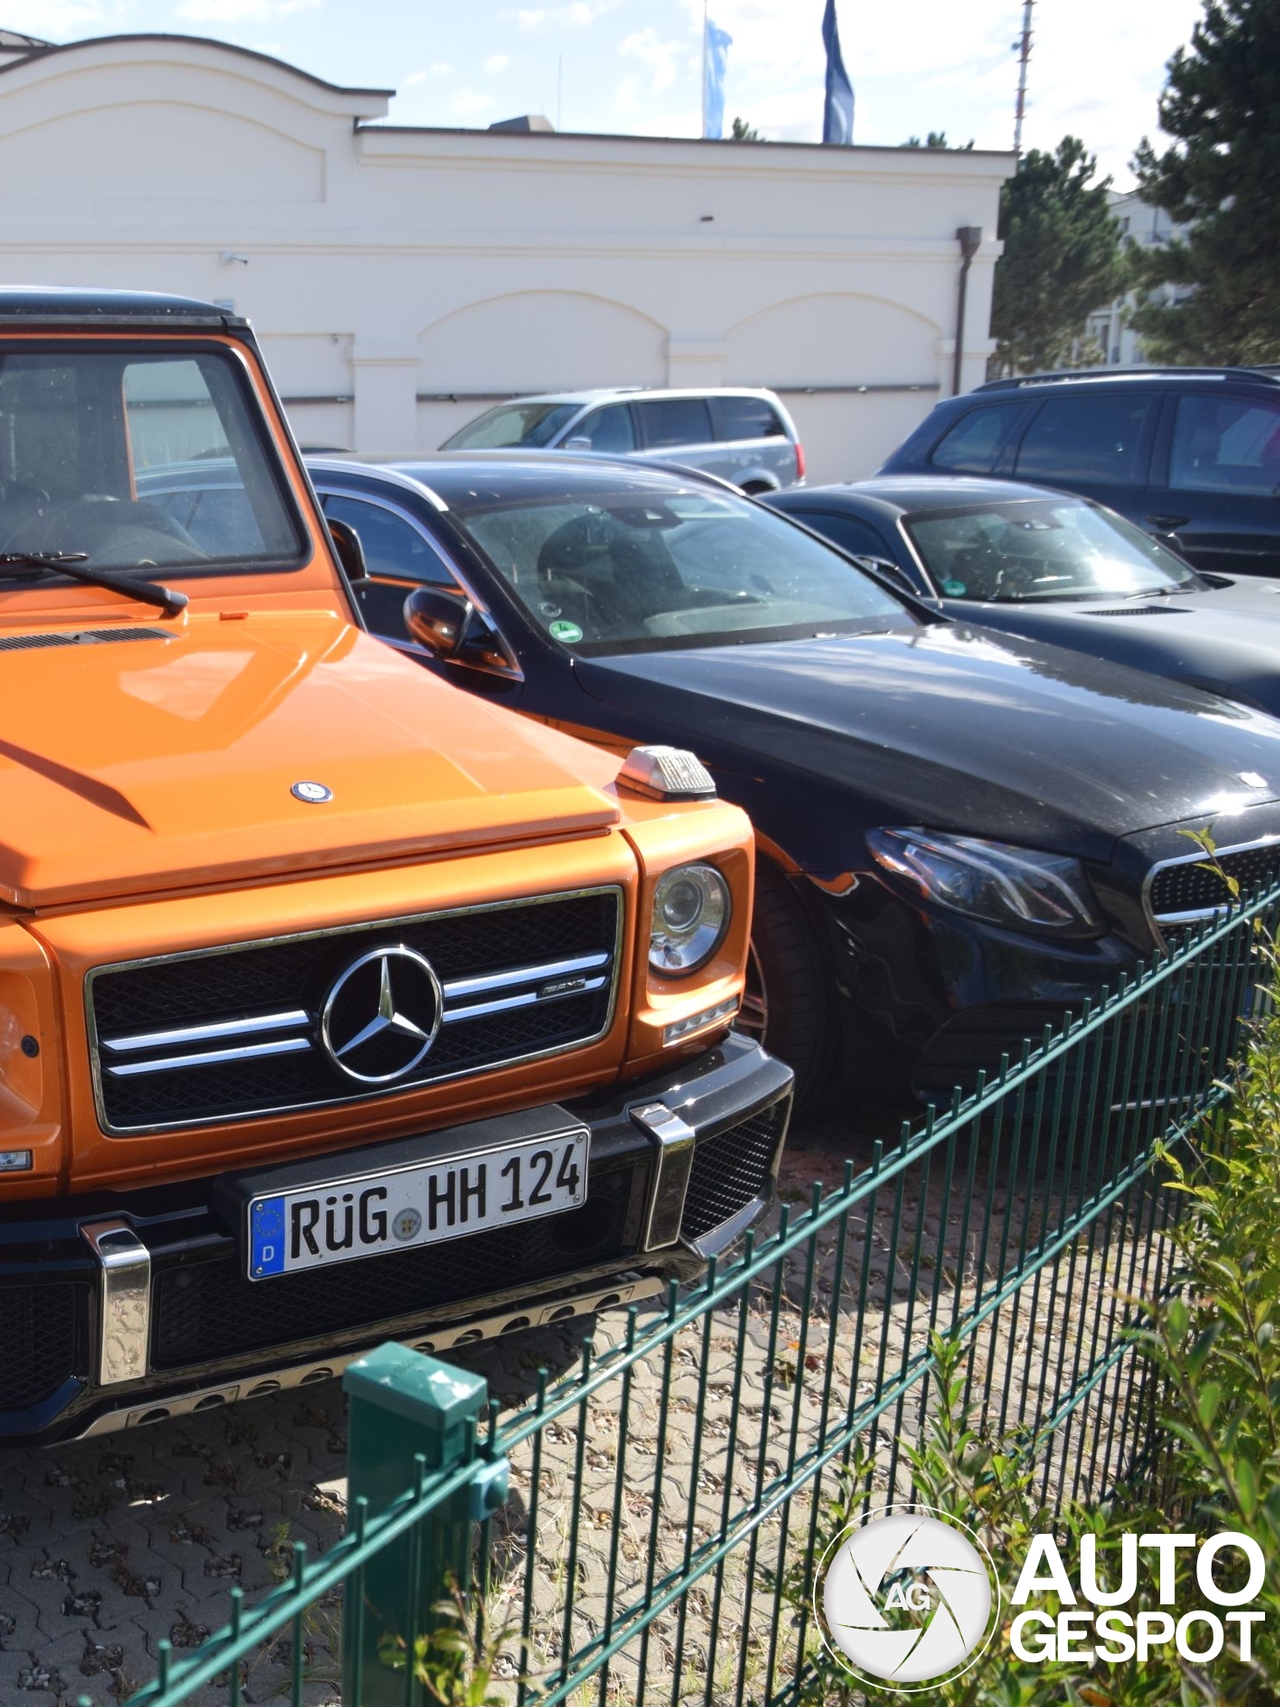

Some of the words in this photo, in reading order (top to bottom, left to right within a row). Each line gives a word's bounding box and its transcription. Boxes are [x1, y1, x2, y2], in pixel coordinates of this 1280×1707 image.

[556, 978, 586, 991] AMG
[428, 1163, 487, 1231] HH
[501, 1143, 580, 1213] 124
[262, 1244, 275, 1263] D
